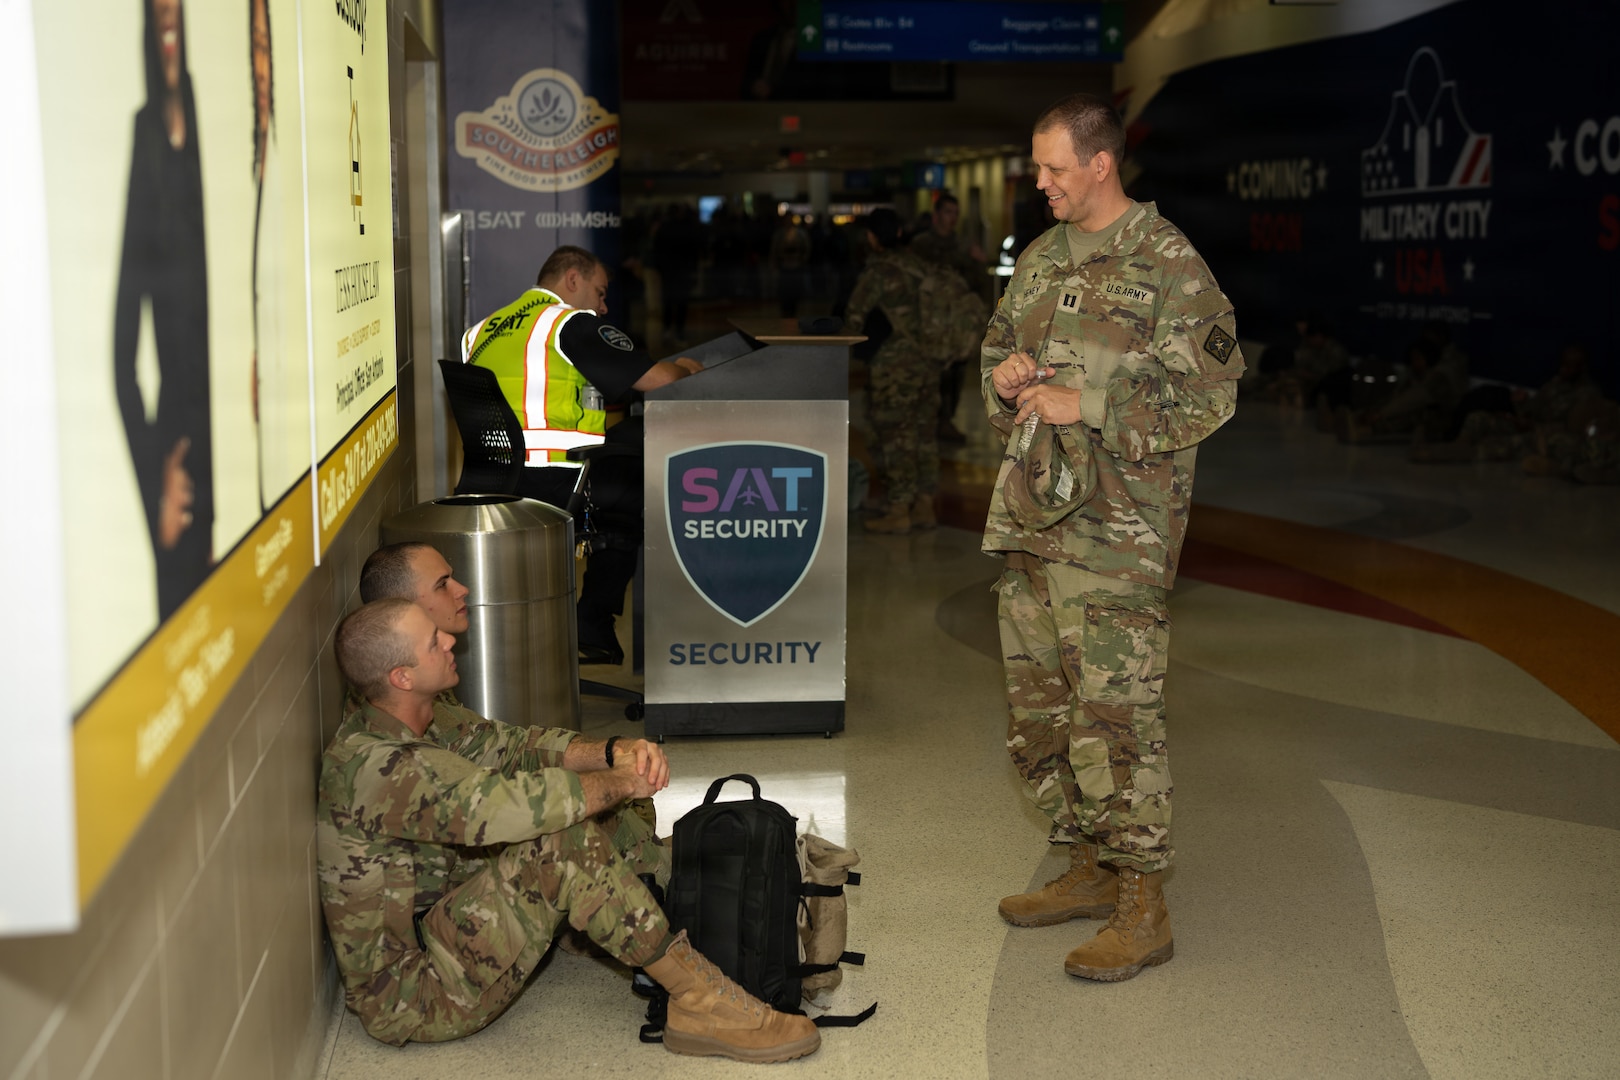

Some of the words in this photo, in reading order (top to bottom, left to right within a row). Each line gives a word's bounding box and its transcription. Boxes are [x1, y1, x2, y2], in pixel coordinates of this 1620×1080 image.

[634, 43, 729, 62] AGUIRRE
[969, 40, 1008, 54] Ground
[1012, 40, 1081, 55] Transportation
[472, 127, 618, 170] SOUTHERLEIGH
[509, 169, 538, 185] FOOD
[541, 176, 563, 185] AND
[1238, 158, 1311, 200] COMING
[477, 211, 526, 230] SAT
[1250, 212, 1303, 253] SOON
[1360, 202, 1440, 243] MILITARY
[1444, 199, 1492, 241] CITY
[1395, 248, 1449, 298] USA
[320, 467, 338, 531] Call
[345, 441, 360, 501] 24/7
[681, 467, 813, 513] SAT
[684, 519, 808, 539] SECURITY
[669, 641, 822, 666] SECURITY
